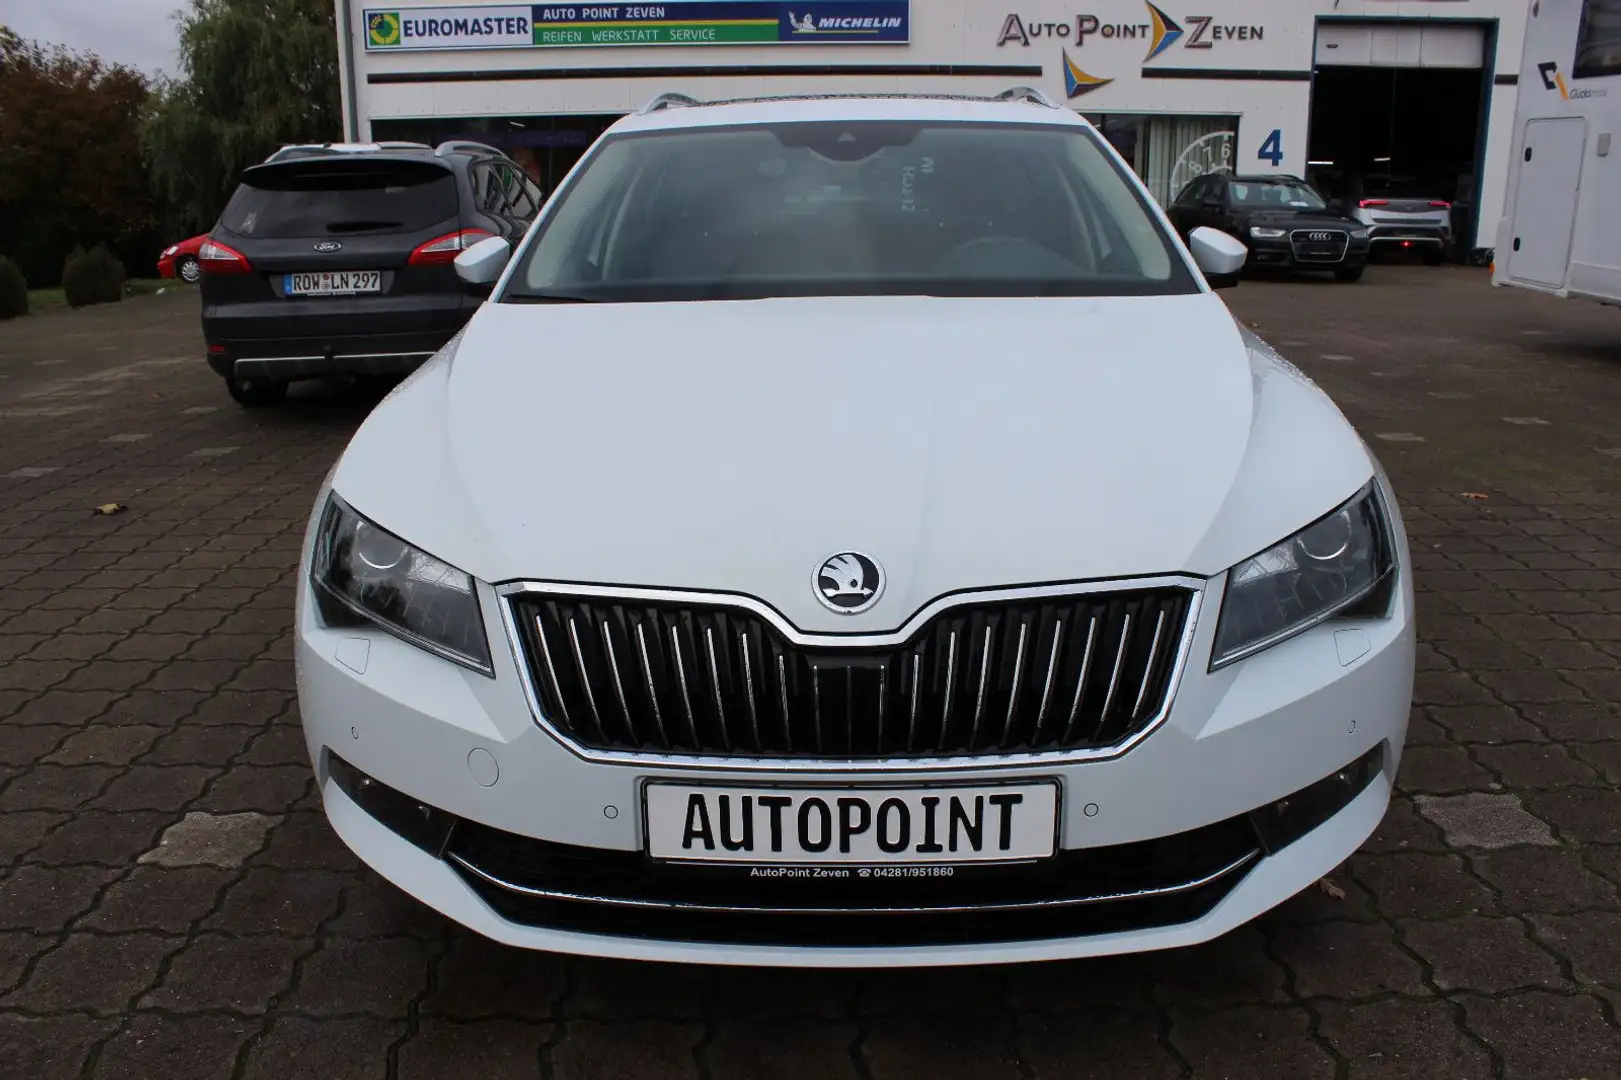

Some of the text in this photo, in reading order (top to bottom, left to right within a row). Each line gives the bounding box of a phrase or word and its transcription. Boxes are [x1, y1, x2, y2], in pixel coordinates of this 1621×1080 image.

[543, 6, 665, 20] AUTO POINT ZEVEN
[403, 17, 528, 37] EUROMASTER
[818, 16, 902, 28] MICHELIN
[543, 28, 716, 43] REIFEN WERKSTATT SERVICE
[1221, 143, 1231, 158] 6
[1257, 129, 1284, 167] 4
[293, 272, 379, 291] ROW LN 297
[682, 793, 1023, 853] AUTOPOINT
[750, 867, 954, 877] AutoPoint Zeven 04281/951860
